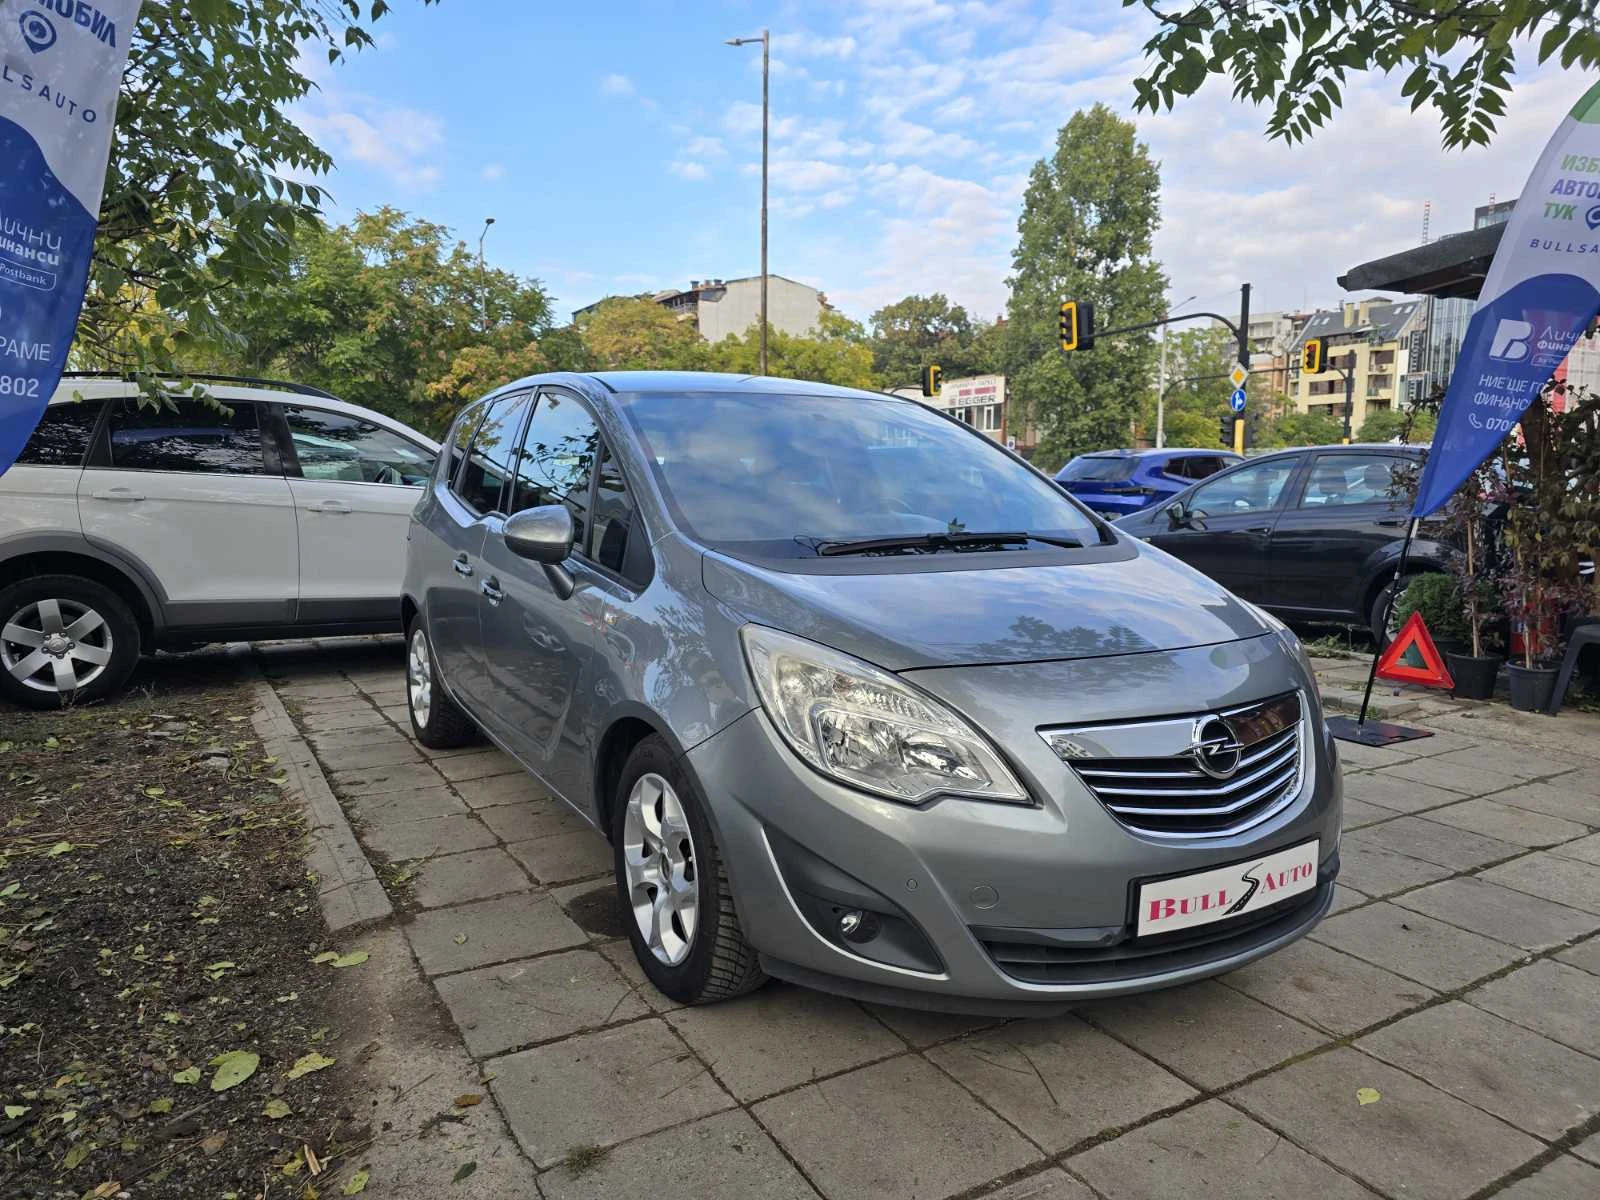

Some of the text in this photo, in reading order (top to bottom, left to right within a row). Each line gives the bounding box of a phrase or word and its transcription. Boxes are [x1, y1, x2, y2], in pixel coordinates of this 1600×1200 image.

[3, 64, 97, 123] LSAUTO
[1560, 153, 1600, 174] ИЗБ
[1550, 178, 1600, 200] АВТО
[1543, 201, 1578, 221] ТУК
[1529, 238, 1600, 254] BULLSA
[0, 262, 47, 286] Postbank
[0, 375, 40, 398] 802
[1478, 374, 1505, 390] НИЕ
[959, 394, 997, 406] EGGER
[1147, 889, 1232, 922] BULL
[1260, 861, 1314, 895] AUTO
